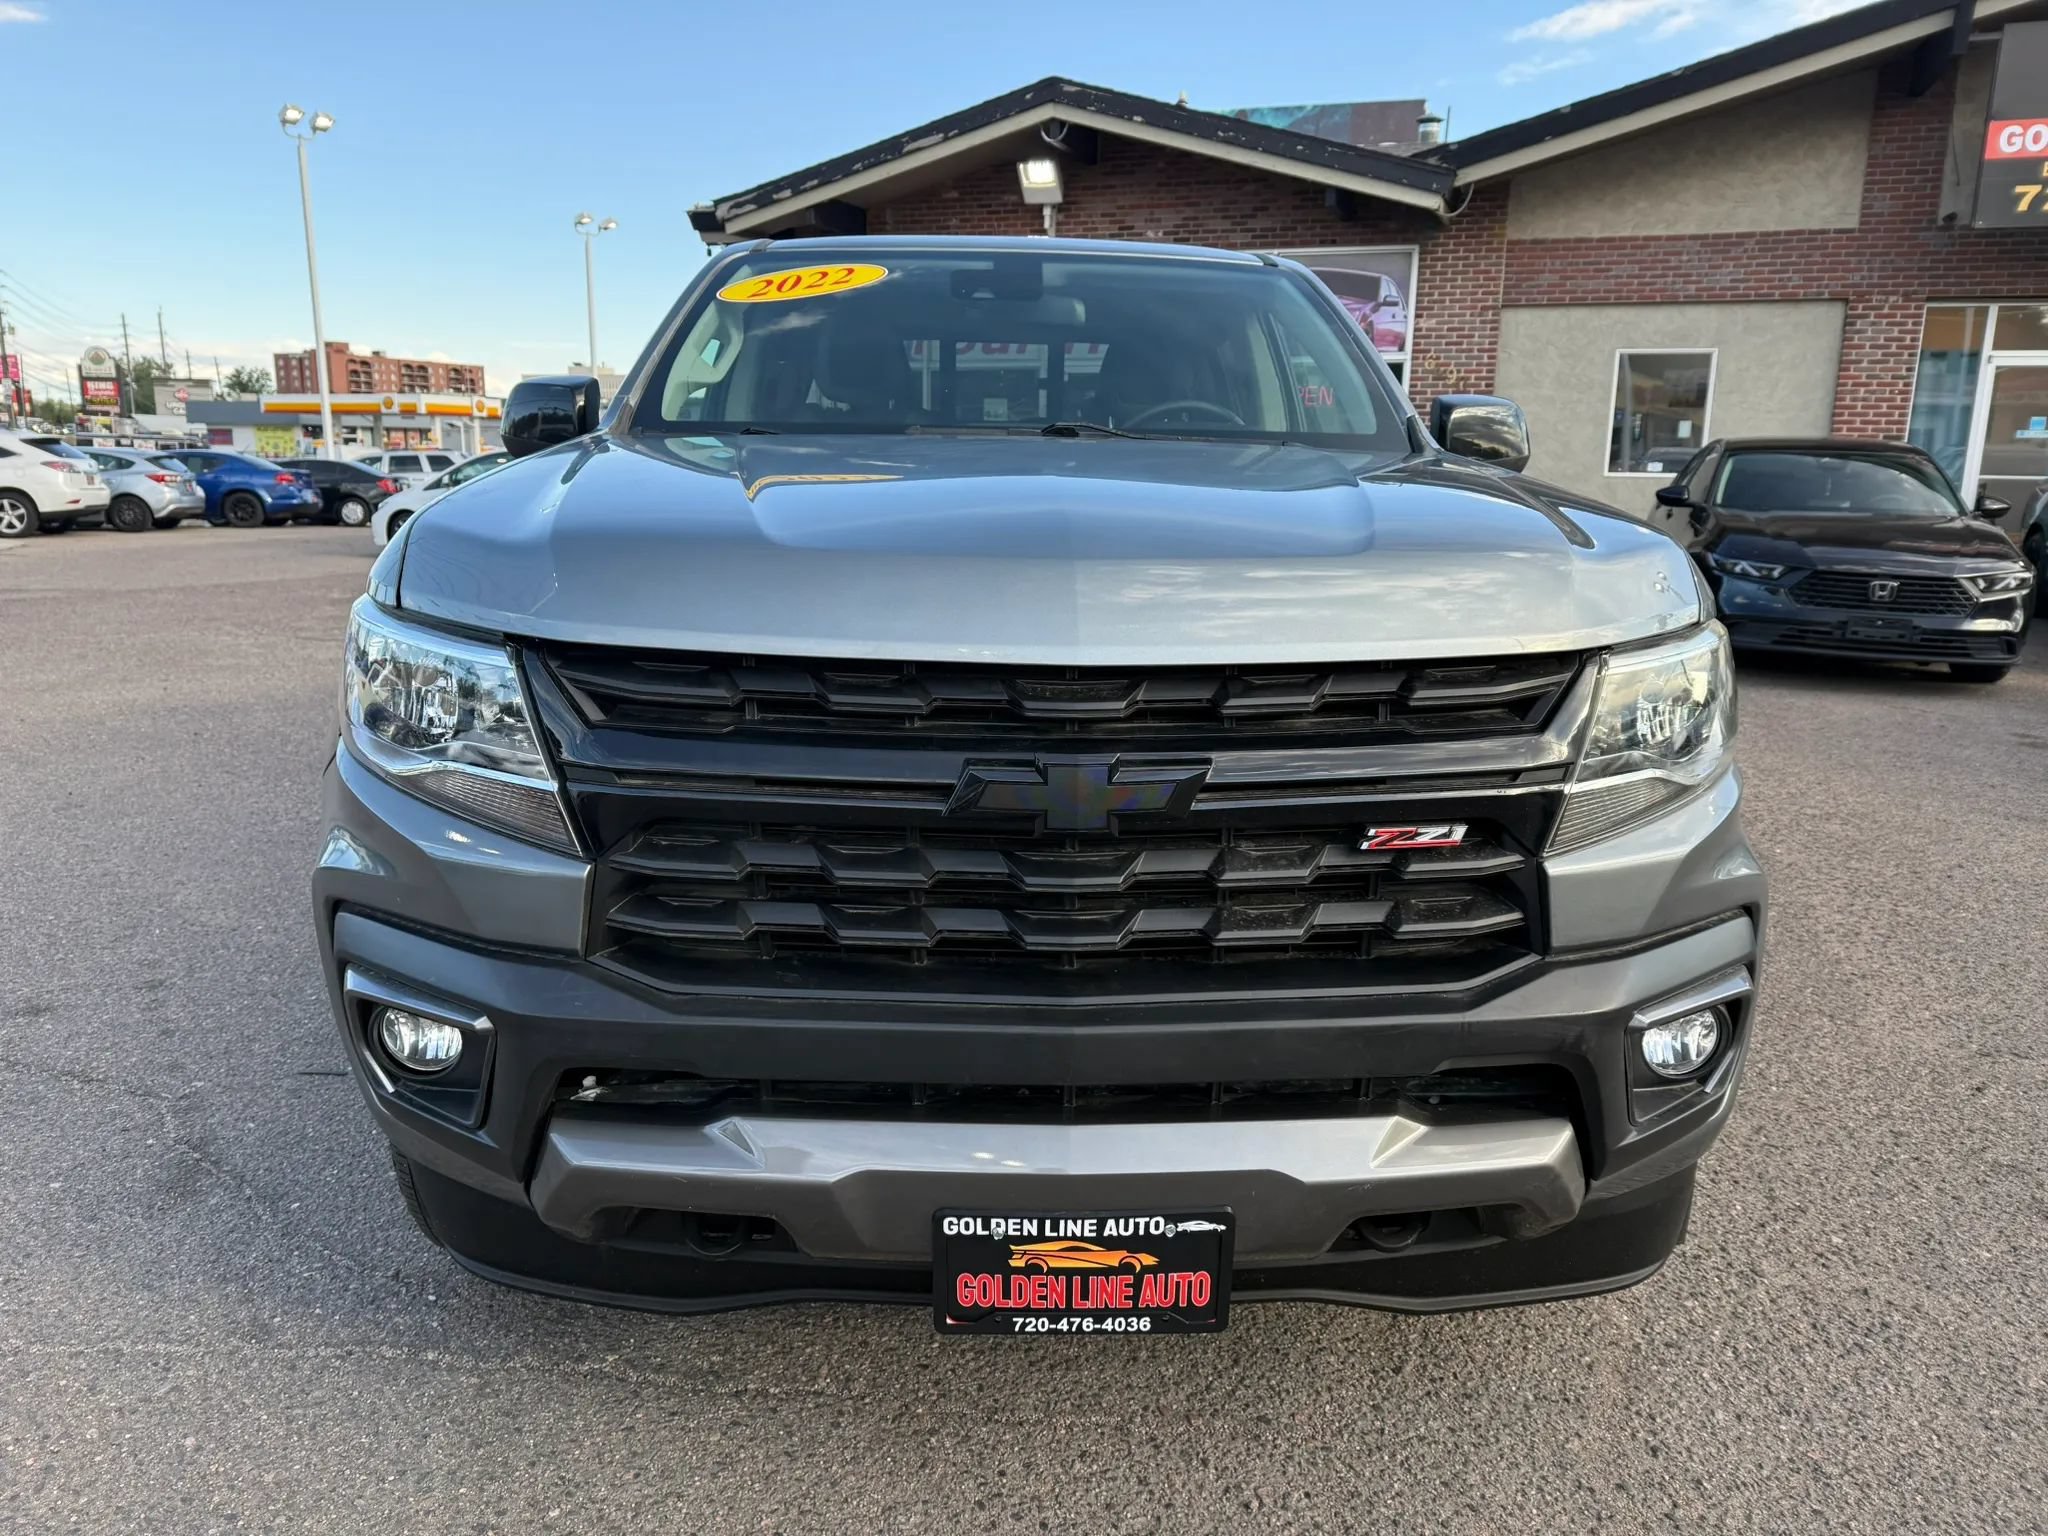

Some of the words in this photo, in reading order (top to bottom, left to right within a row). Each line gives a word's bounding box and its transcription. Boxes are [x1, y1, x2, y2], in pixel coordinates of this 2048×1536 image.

[2014, 184, 2048, 211] 7
[747, 267, 855, 298] 2022
[1296, 385, 1335, 407] PEN
[1360, 825, 1469, 849] Z71
[943, 1216, 1038, 1236] GOLDEN
[1044, 1218, 1098, 1237] LINE
[1103, 1216, 1165, 1237] AUTO
[957, 1273, 1065, 1308] GOLDEN
[1072, 1276, 1133, 1309] LINE
[1139, 1271, 1211, 1308] AUTO
[1012, 1317, 1151, 1332] 720-476-4036
